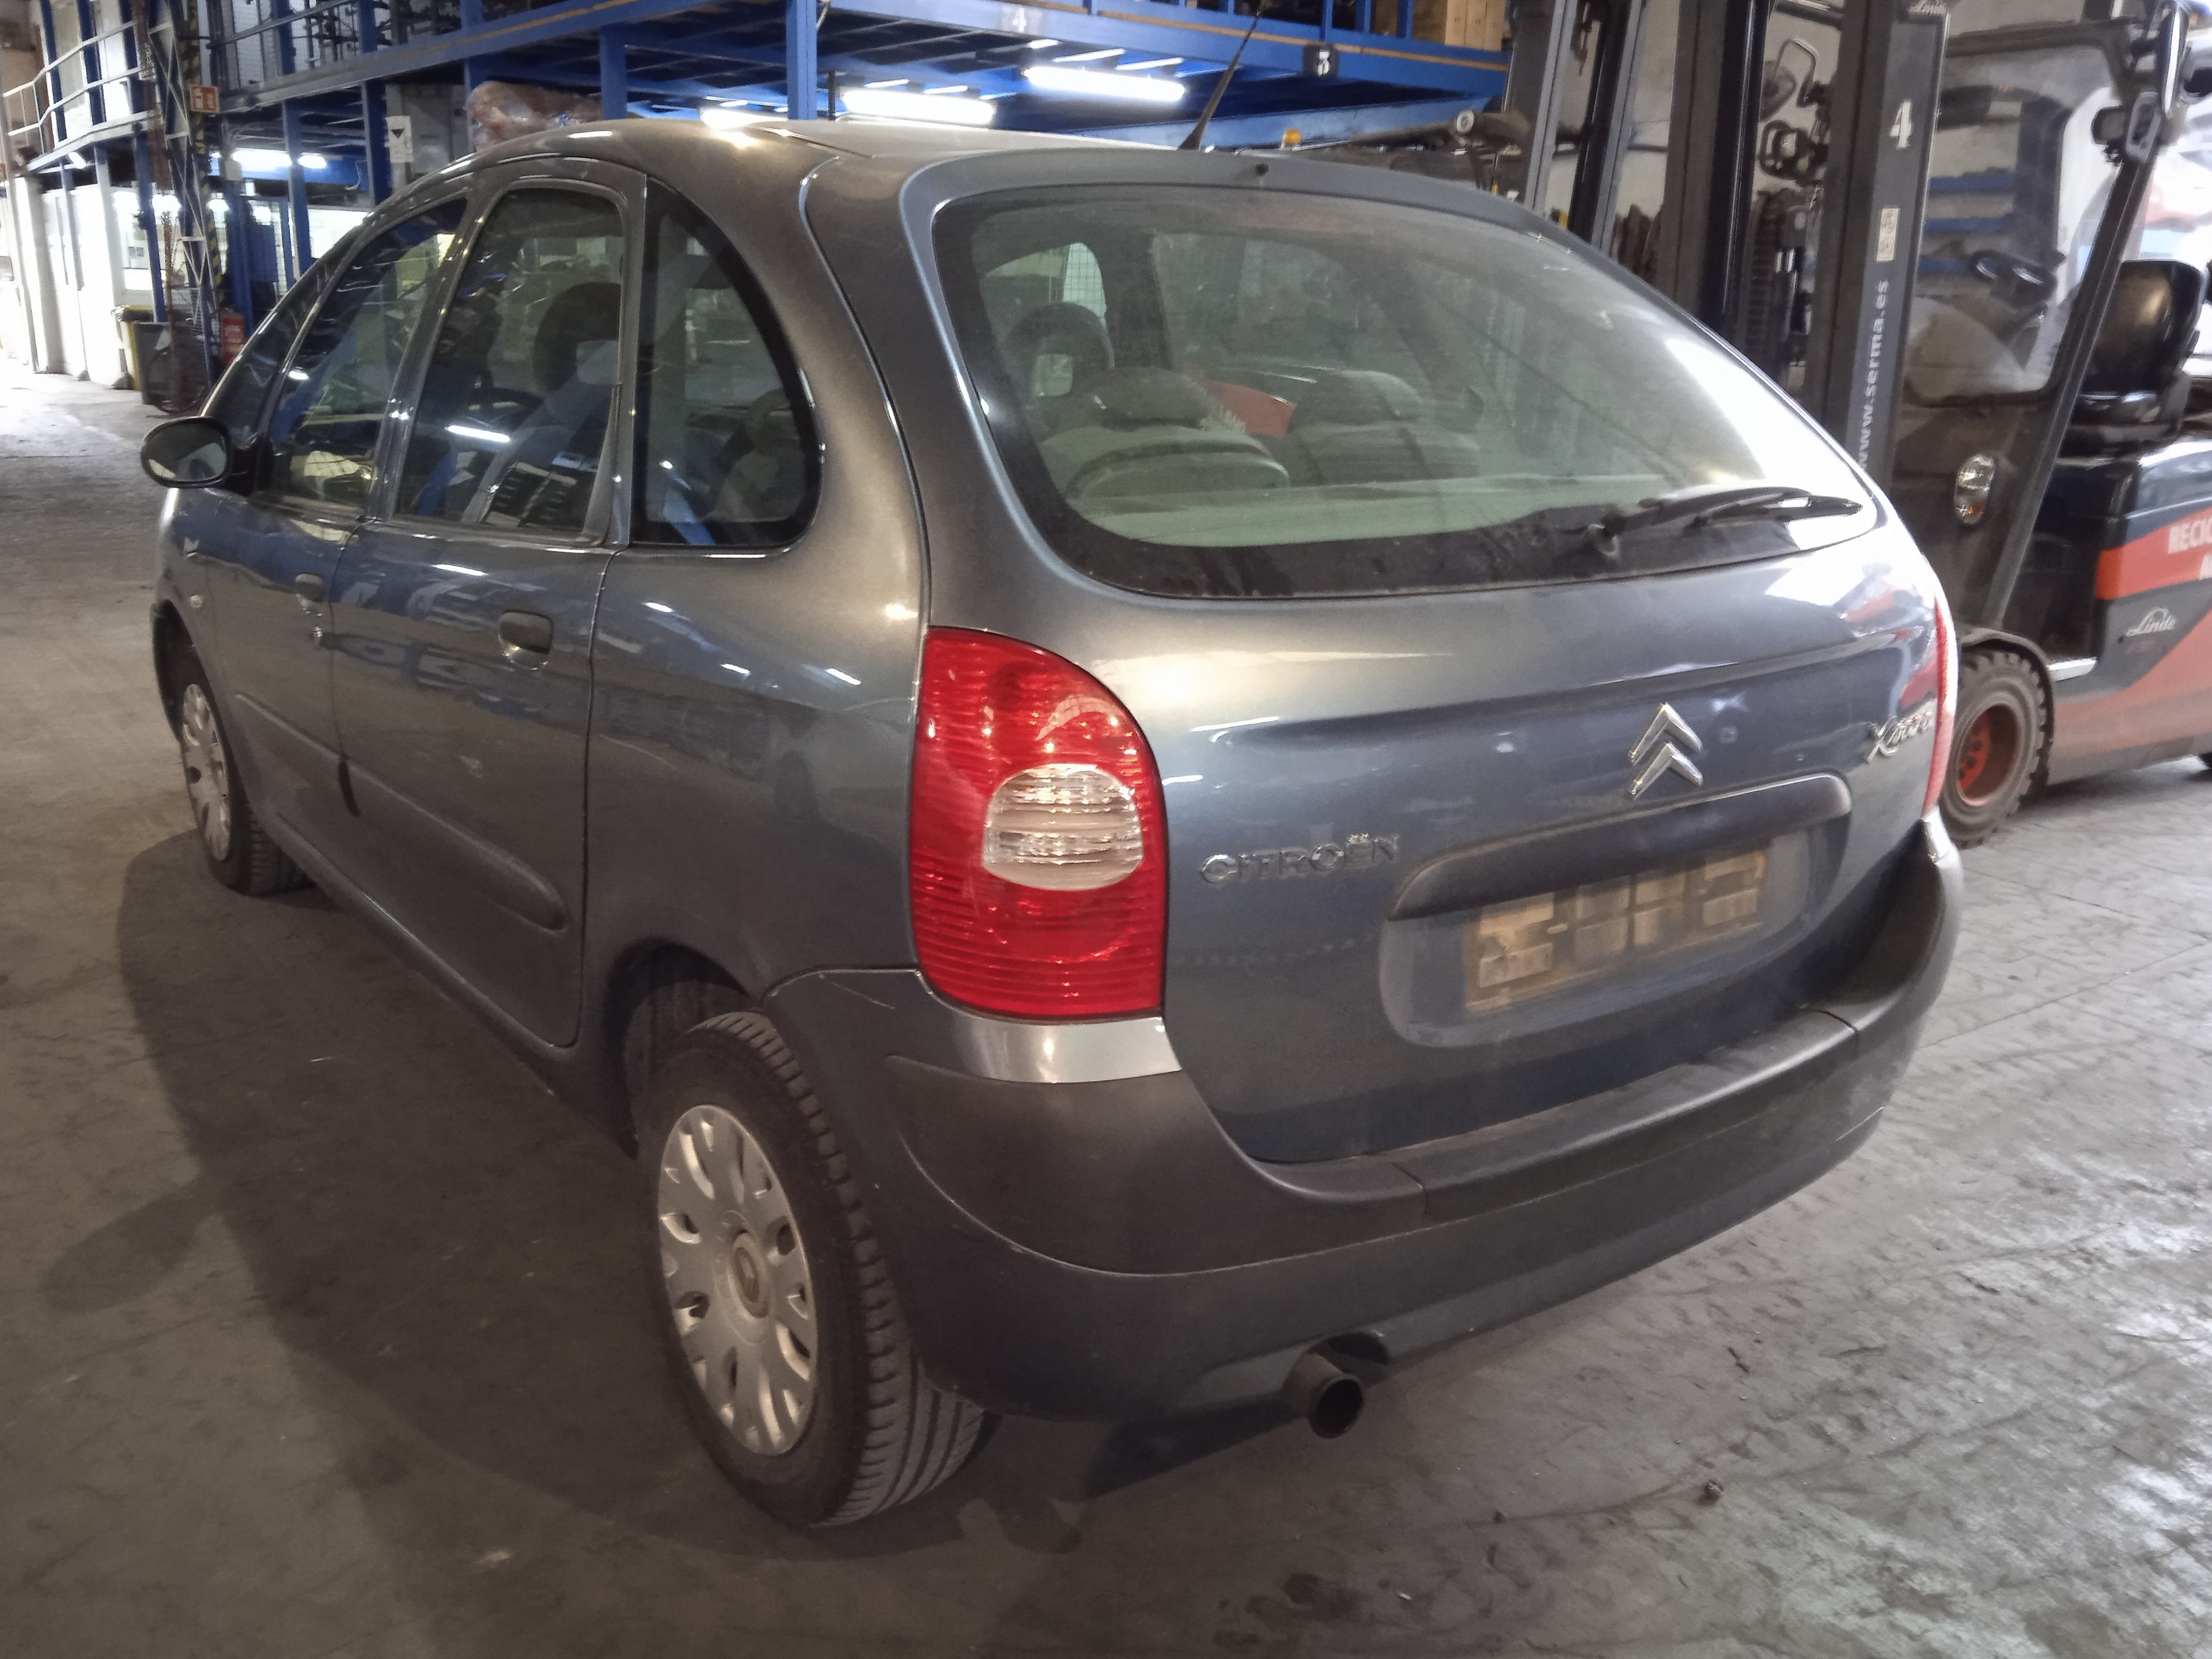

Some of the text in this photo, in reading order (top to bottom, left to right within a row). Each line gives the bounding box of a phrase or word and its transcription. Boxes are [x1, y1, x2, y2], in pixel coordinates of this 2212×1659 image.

[1012, 6, 1027, 33] 4
[1890, 101, 1912, 148] 4
[2126, 607, 2176, 637] Linde
[1200, 832, 1401, 884] CITROËN
